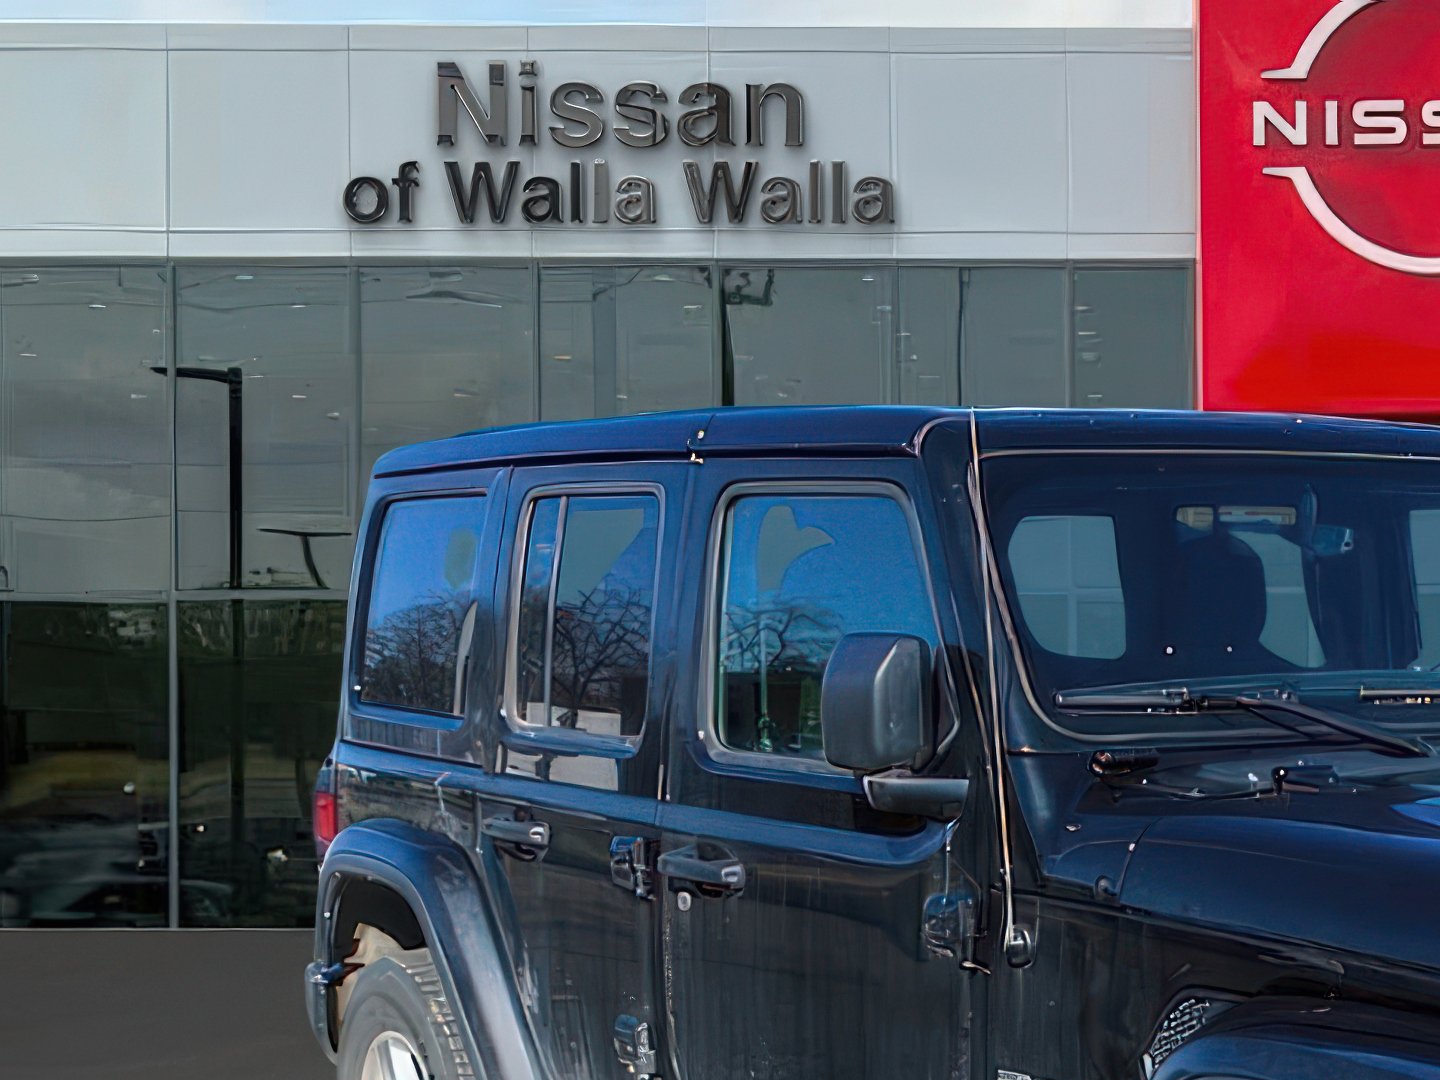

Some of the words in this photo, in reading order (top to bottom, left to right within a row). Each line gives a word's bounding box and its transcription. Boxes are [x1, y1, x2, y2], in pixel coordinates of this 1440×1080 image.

[436, 60, 804, 148] Nissan
[342, 160, 420, 225] of
[443, 160, 659, 225] Walla
[682, 160, 896, 225] Walla
